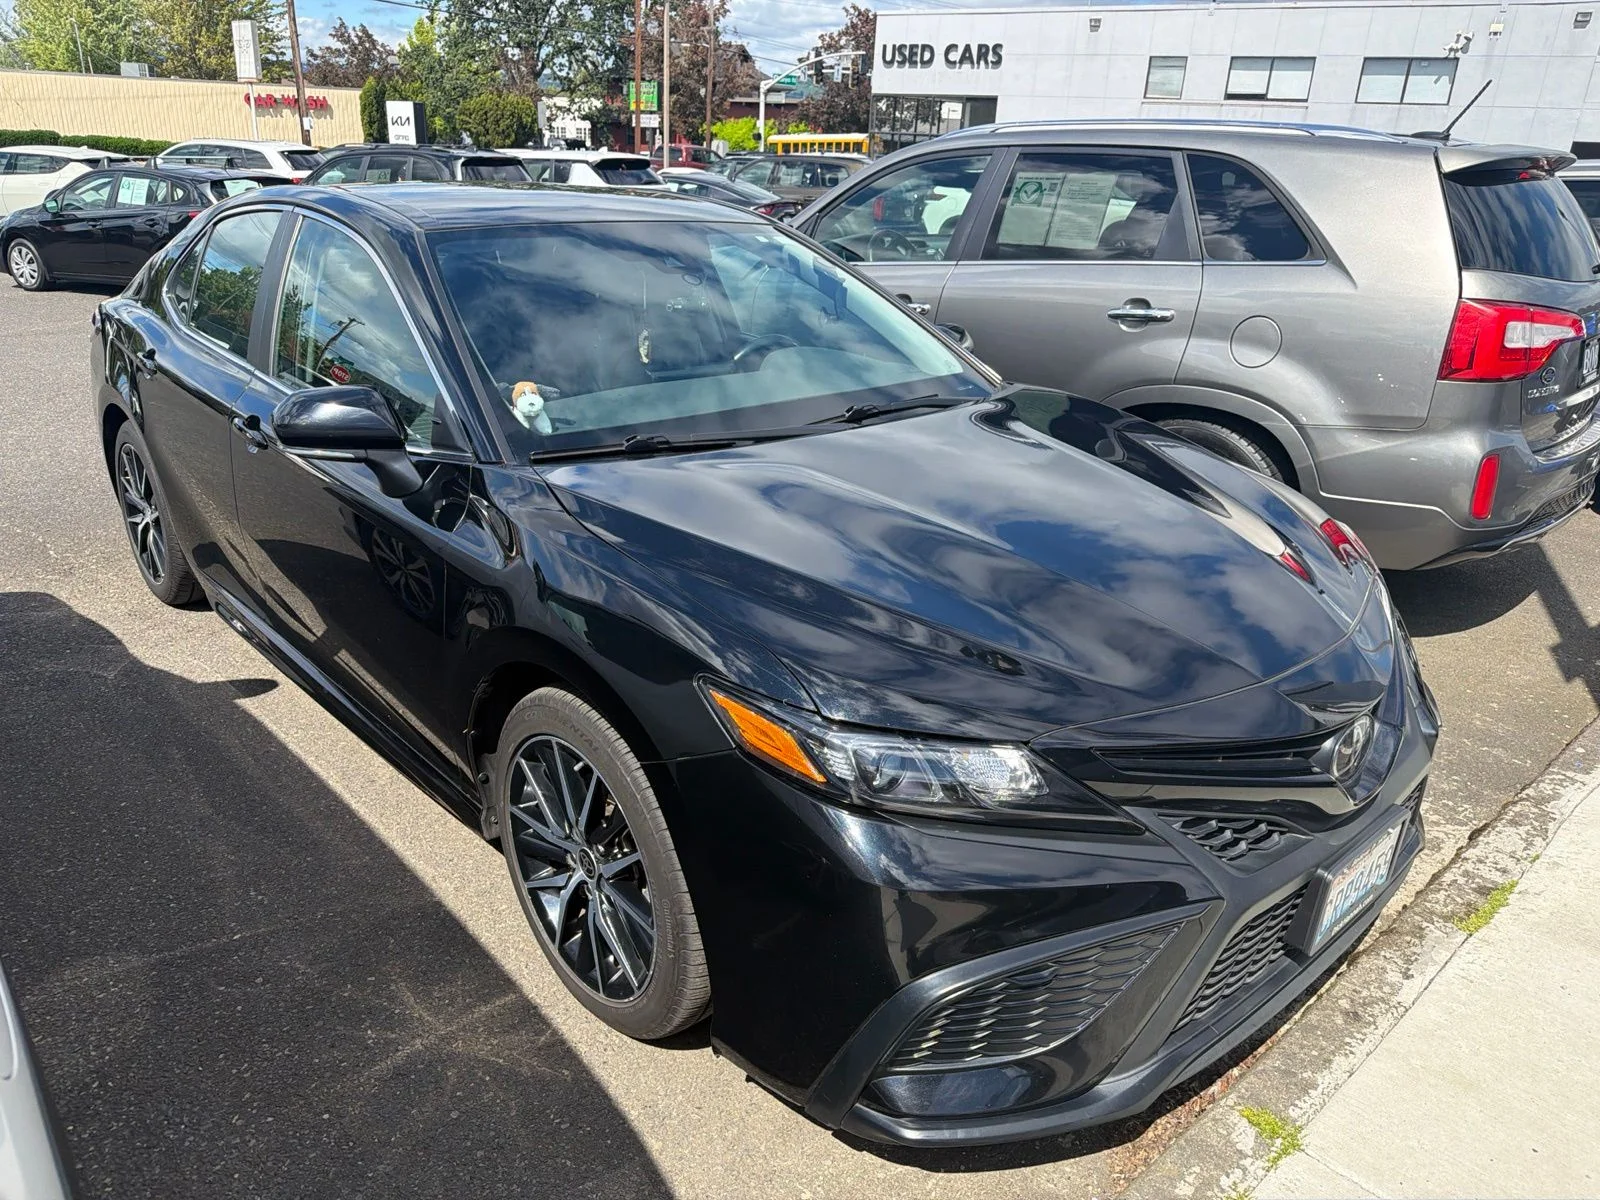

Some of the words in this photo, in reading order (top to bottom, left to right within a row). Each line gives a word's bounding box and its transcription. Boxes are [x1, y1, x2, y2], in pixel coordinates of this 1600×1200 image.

[881, 43, 935, 66] USED
[943, 43, 1003, 66] CARS
[244, 92, 276, 109] CAR
[281, 93, 328, 111] WSH
